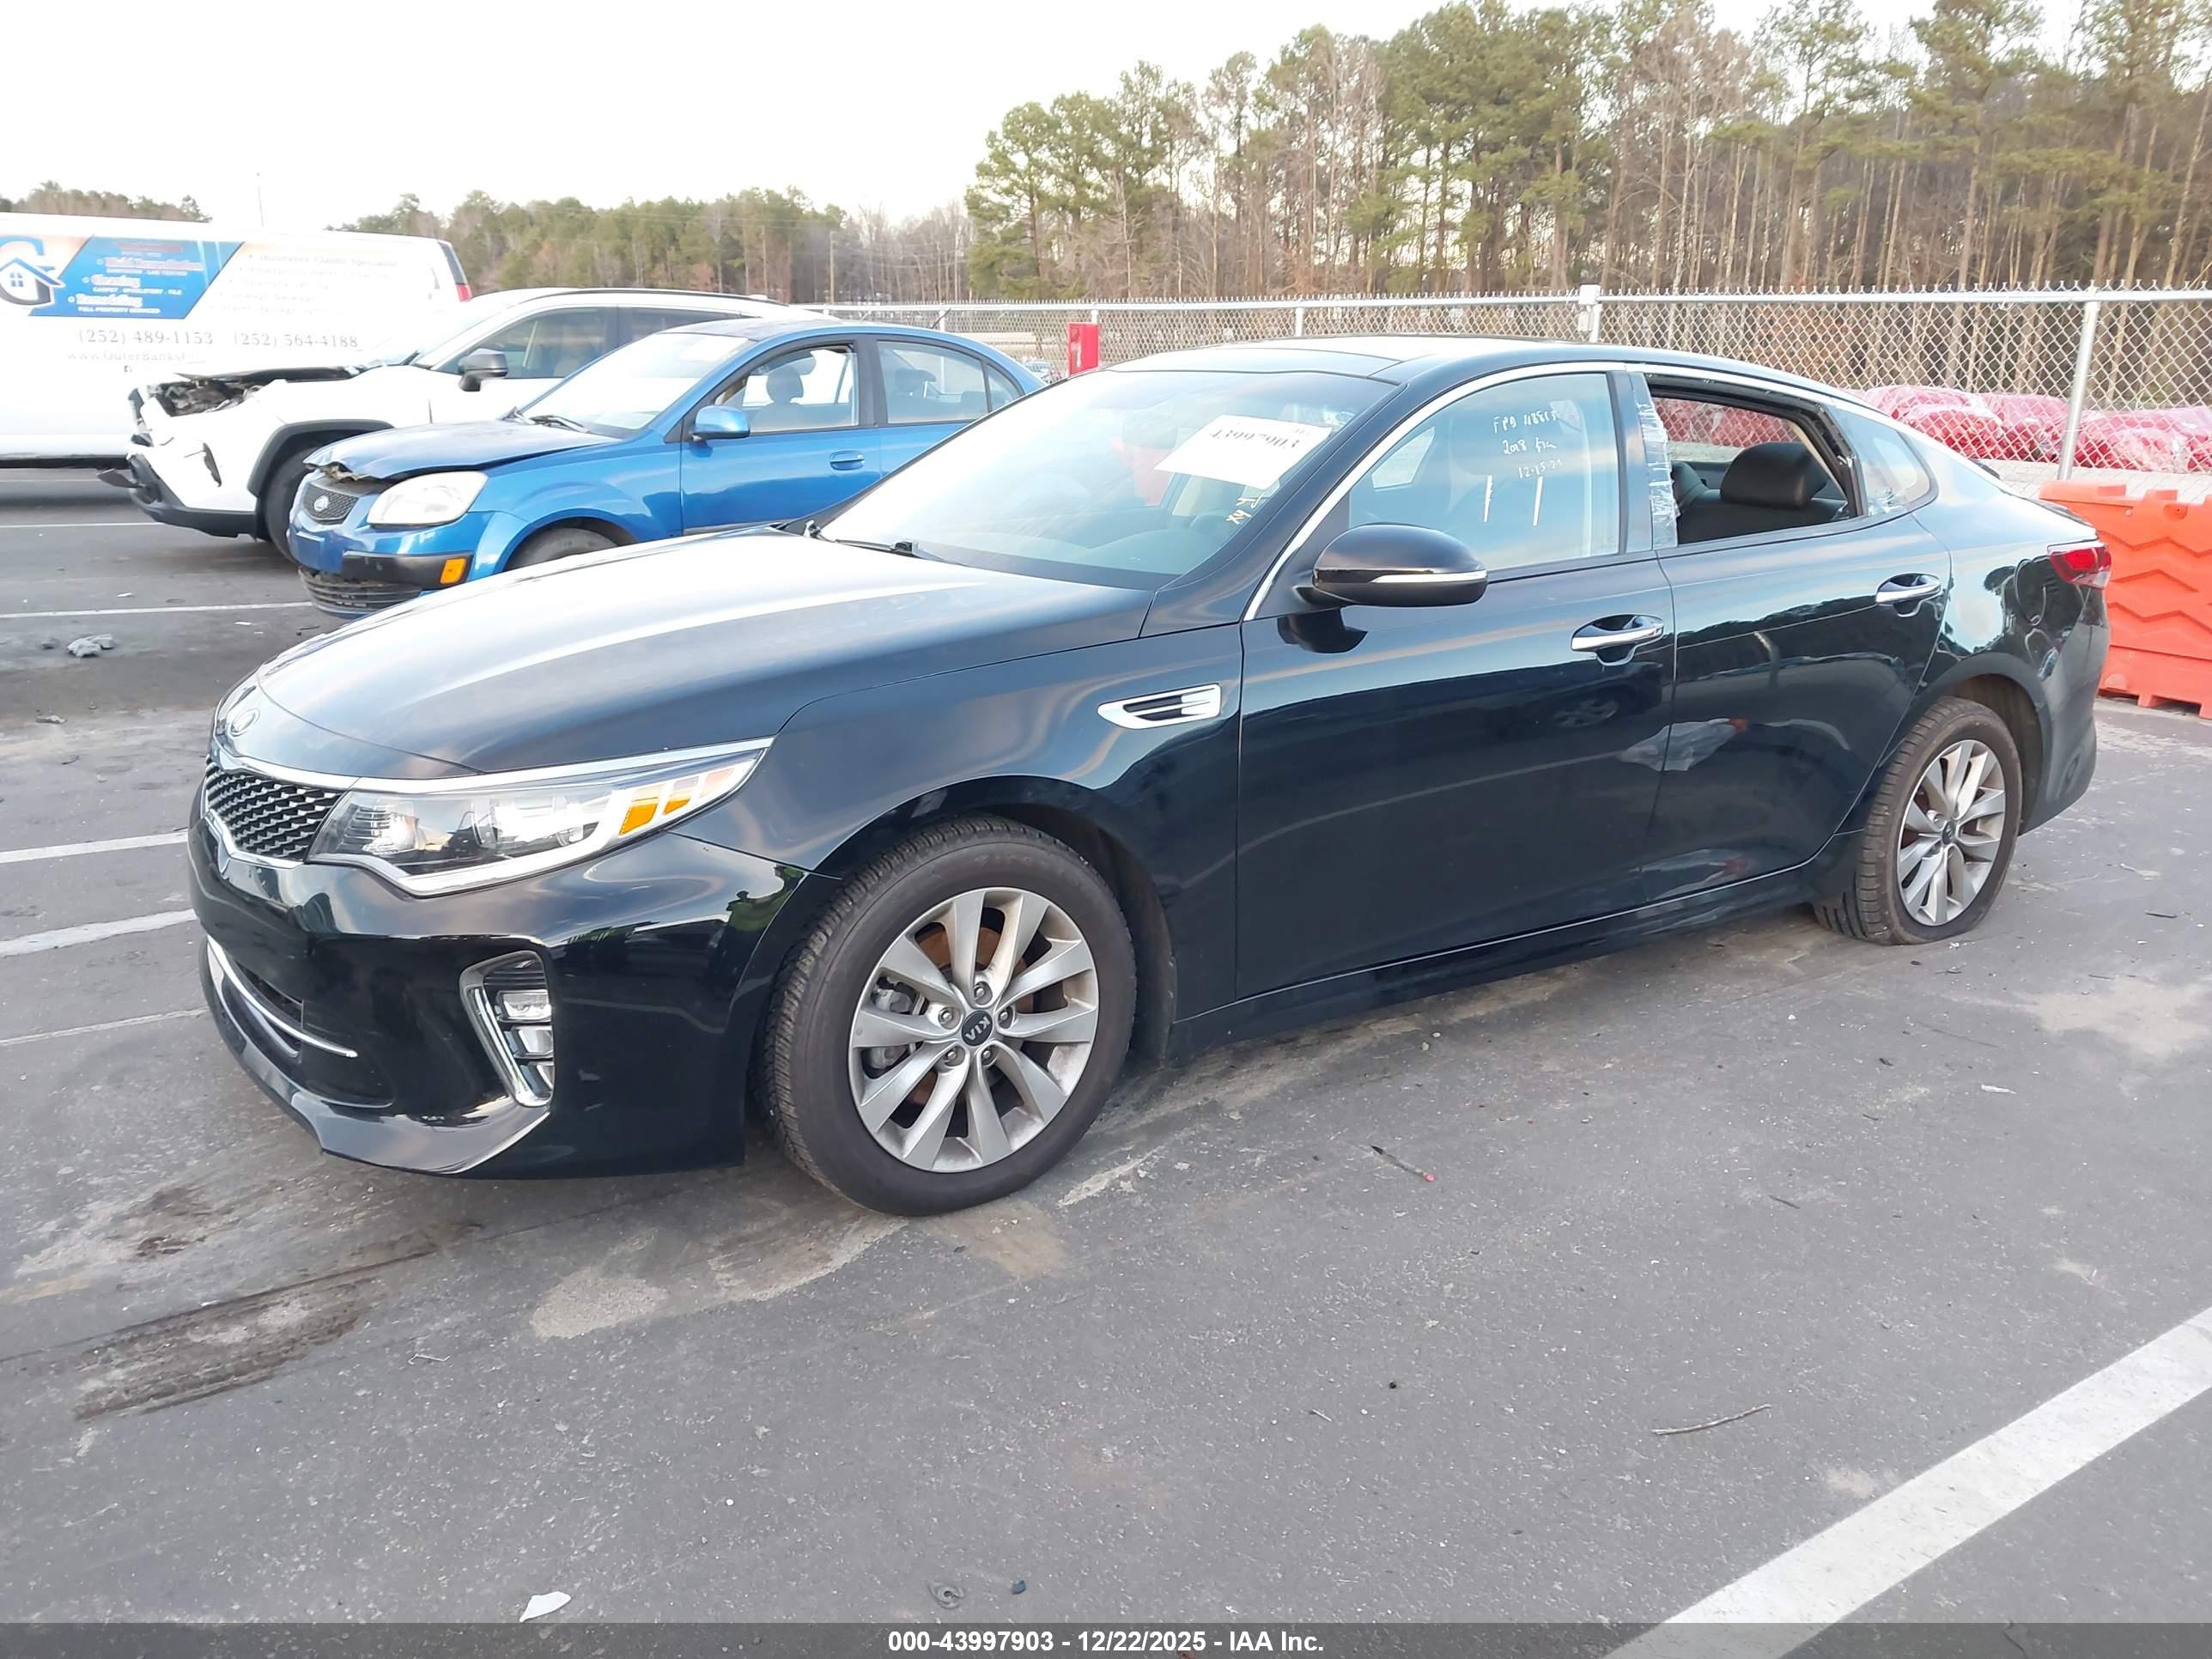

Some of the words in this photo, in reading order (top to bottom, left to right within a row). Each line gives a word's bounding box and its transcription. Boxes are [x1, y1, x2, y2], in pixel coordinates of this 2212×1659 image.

[79, 330, 125, 344] (252)
[133, 330, 213, 344] 489-1153
[234, 331, 276, 348] (252)
